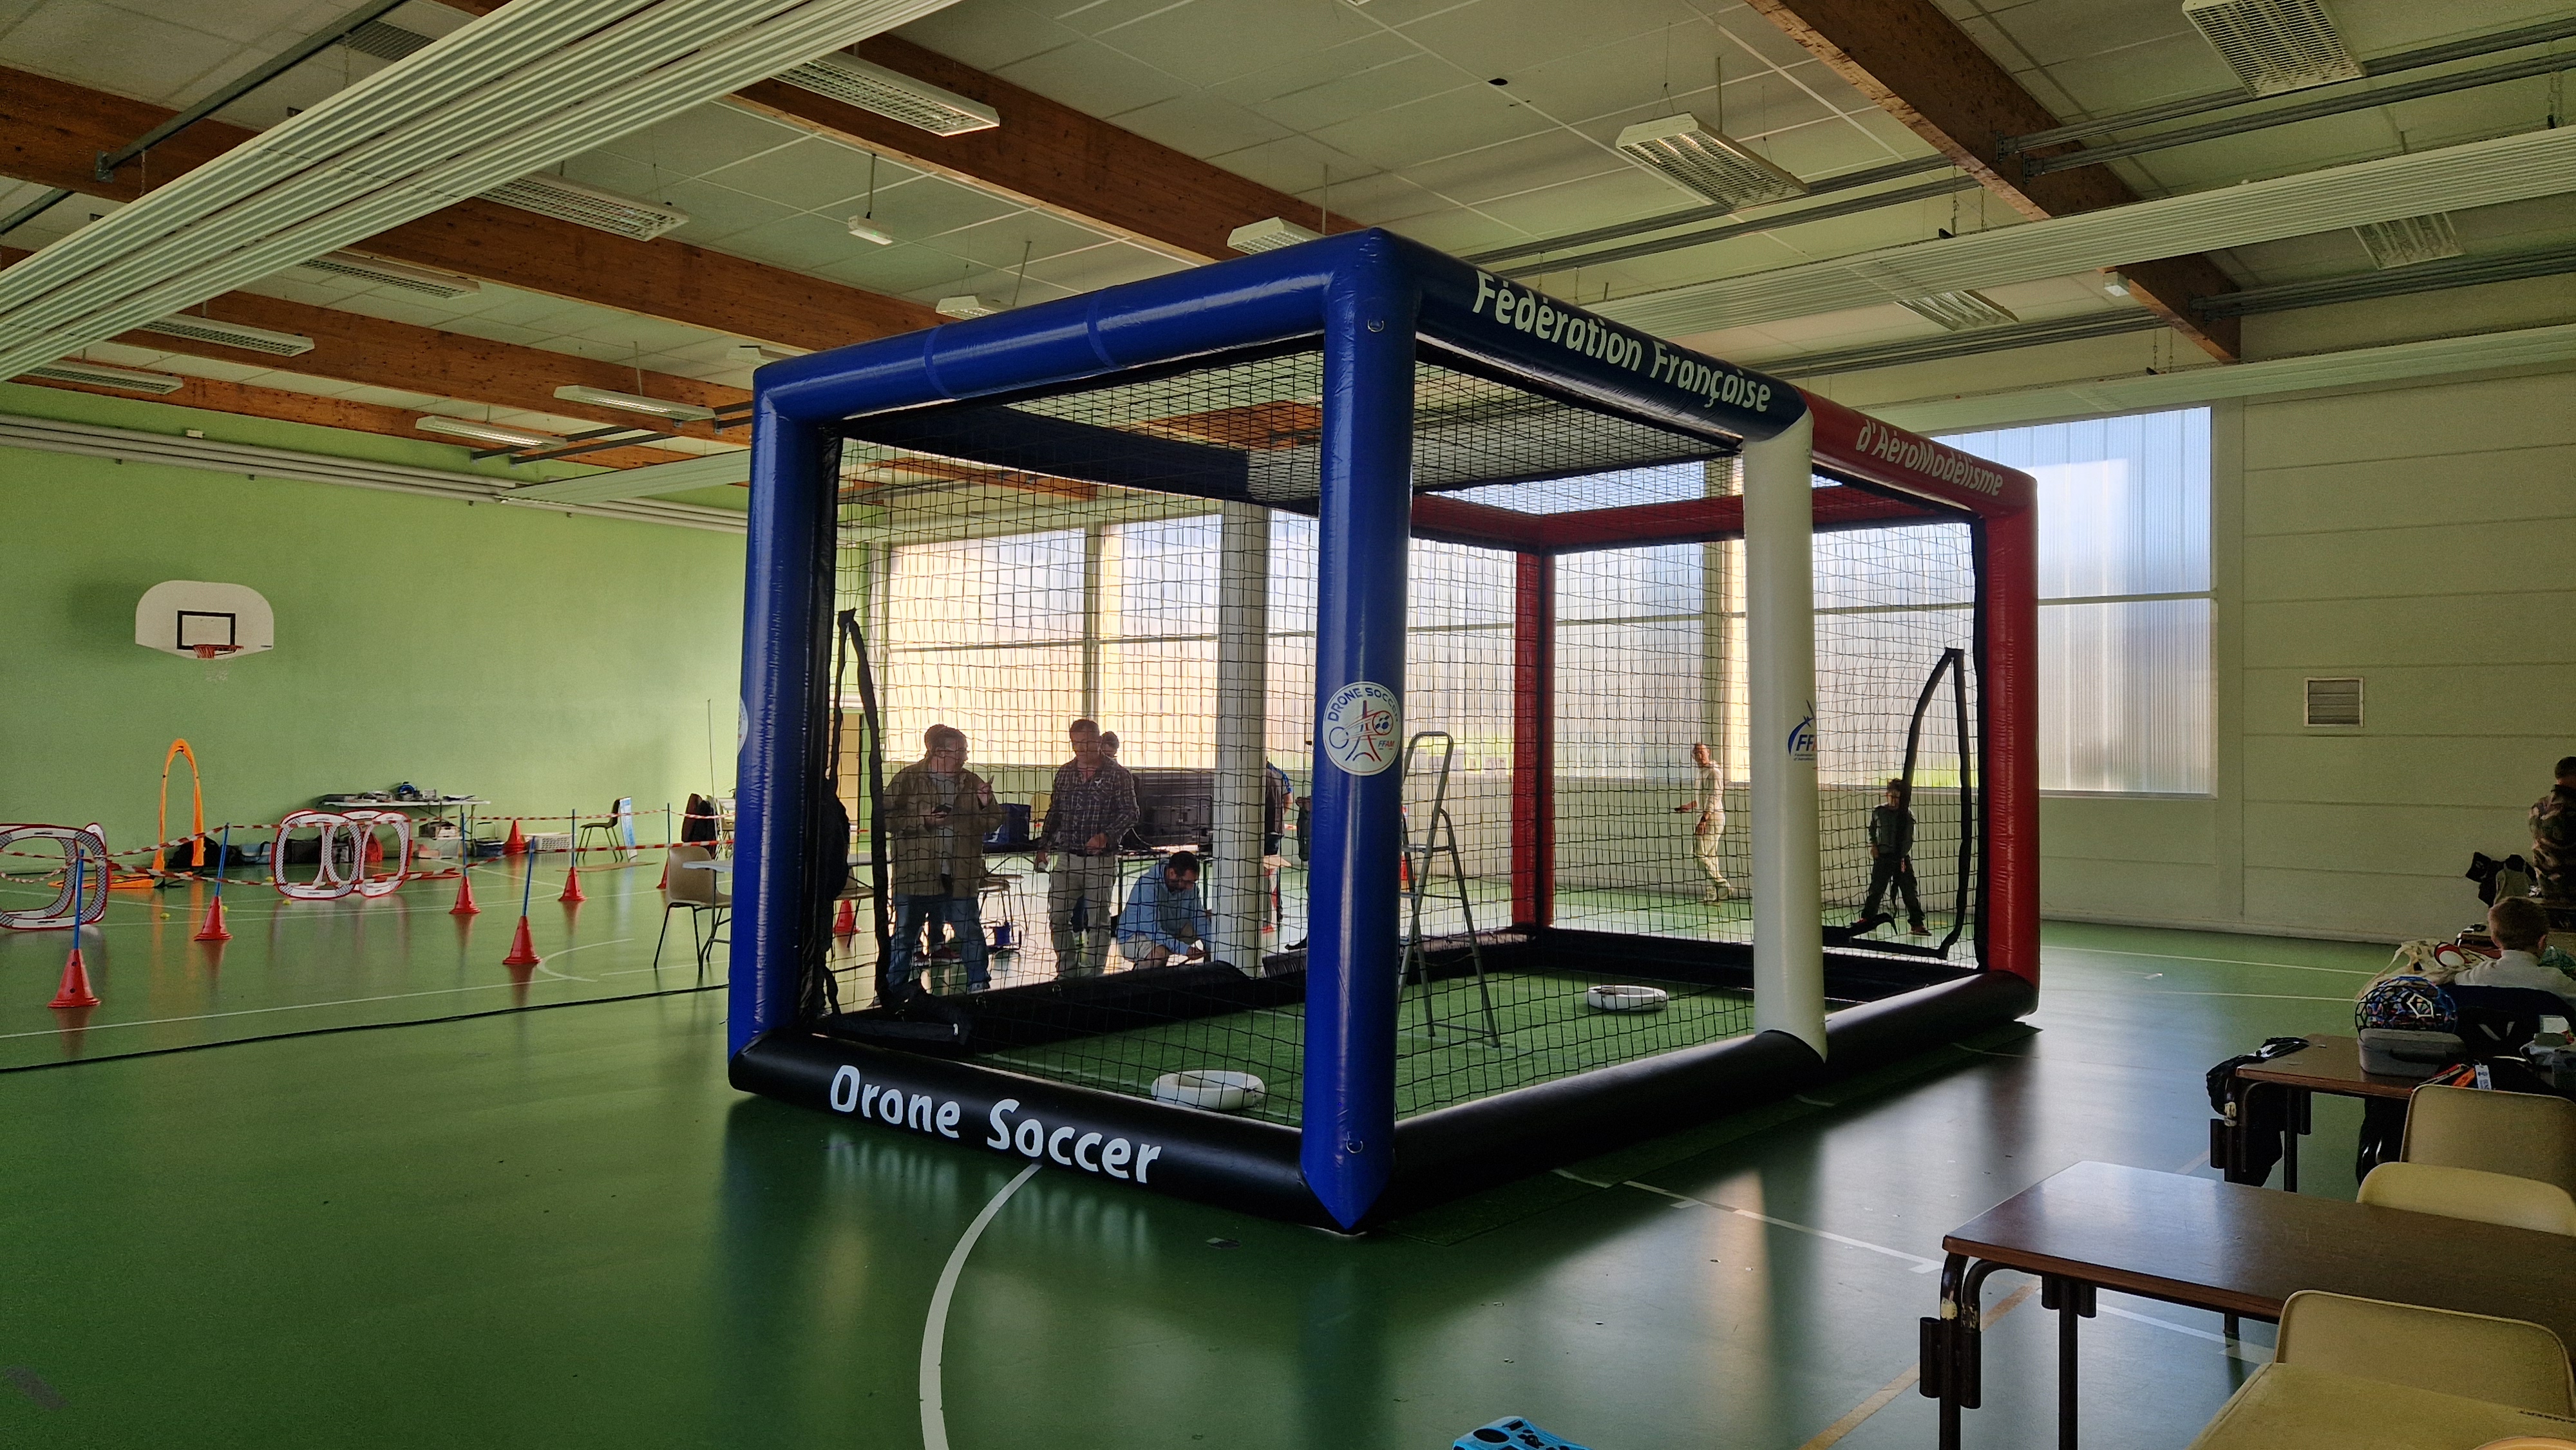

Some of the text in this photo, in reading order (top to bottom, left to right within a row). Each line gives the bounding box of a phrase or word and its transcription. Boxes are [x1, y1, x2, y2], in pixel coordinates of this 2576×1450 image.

[1472, 270, 1771, 412] Fédération Française
[1327, 688, 1363, 722] DRONE
[831, 1064, 1162, 1183] Drone Soccer
